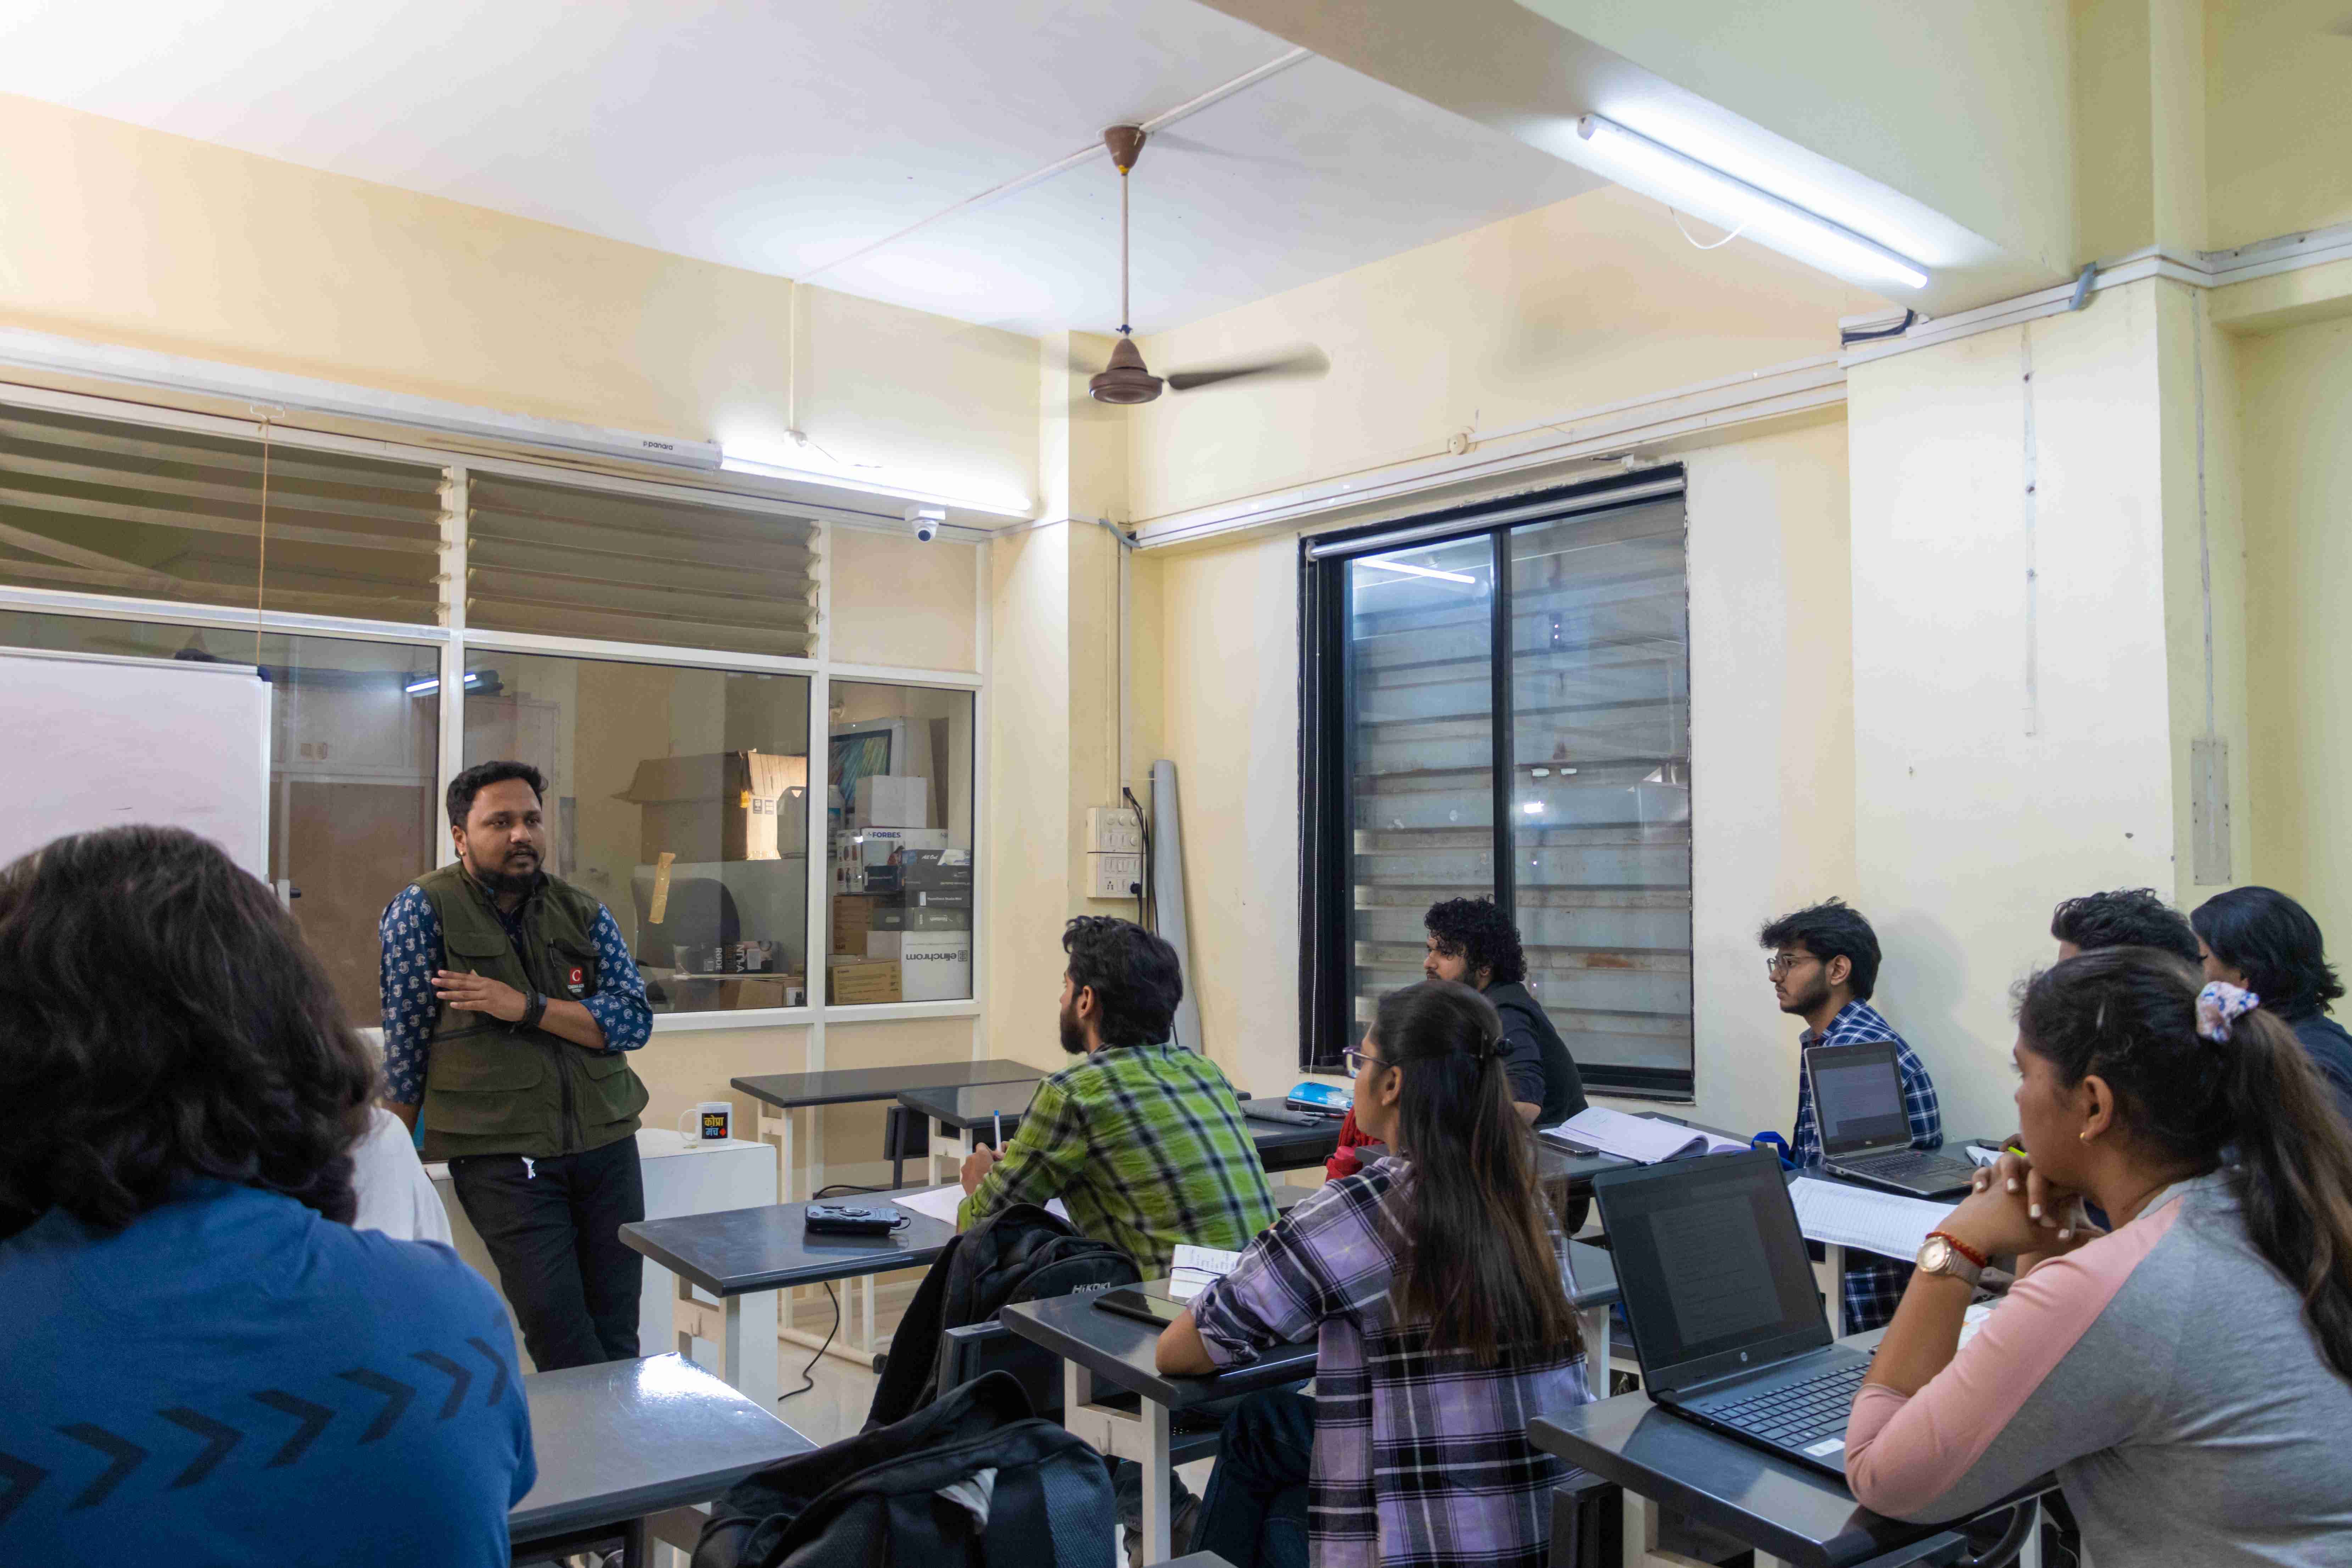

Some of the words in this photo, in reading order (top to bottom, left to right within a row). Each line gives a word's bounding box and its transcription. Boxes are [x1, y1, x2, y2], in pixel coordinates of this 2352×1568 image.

[648, 441, 673, 450] panara
[736, 944, 745, 973] NT1-A
[906, 953, 957, 961] elinchrom
